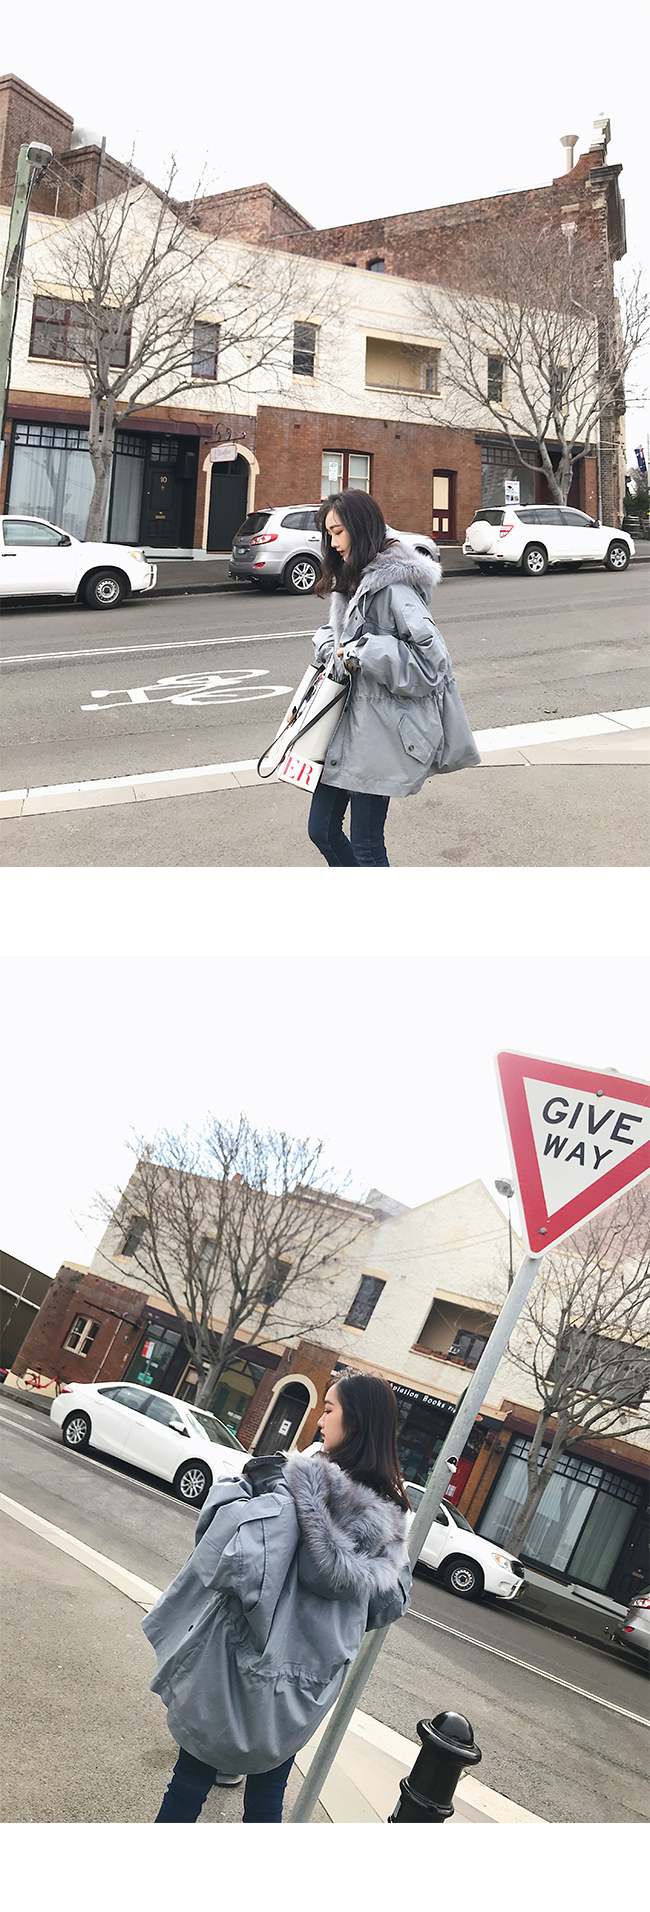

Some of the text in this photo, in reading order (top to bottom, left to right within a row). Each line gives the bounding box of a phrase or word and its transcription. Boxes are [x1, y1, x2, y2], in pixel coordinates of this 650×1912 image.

[542, 1096, 644, 1146] GIVE
[543, 1133, 614, 1170] WAY
[422, 1394, 446, 1409] Books
